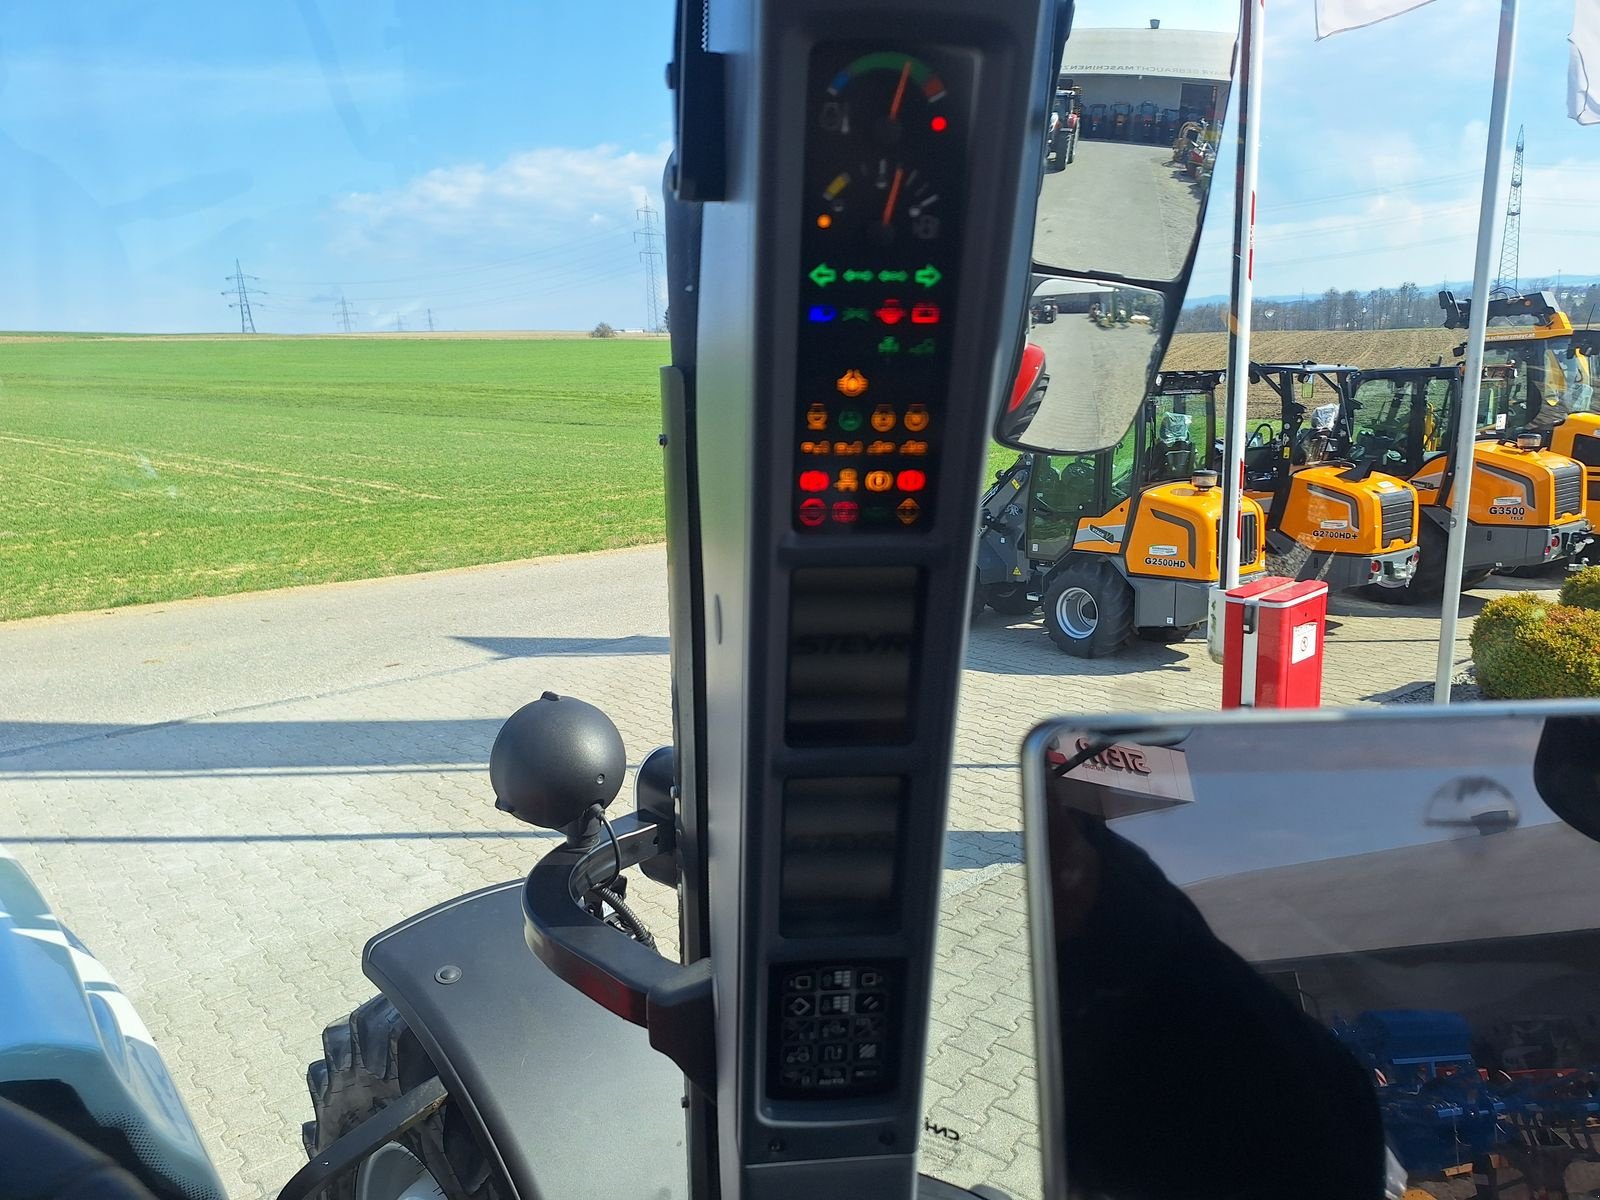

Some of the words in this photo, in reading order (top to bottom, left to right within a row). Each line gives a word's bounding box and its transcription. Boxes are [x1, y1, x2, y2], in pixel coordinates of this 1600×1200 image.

[1489, 506, 1525, 515] G3500
[1312, 530, 1358, 539] G2700HD+
[1144, 557, 1186, 568] G2500HD
